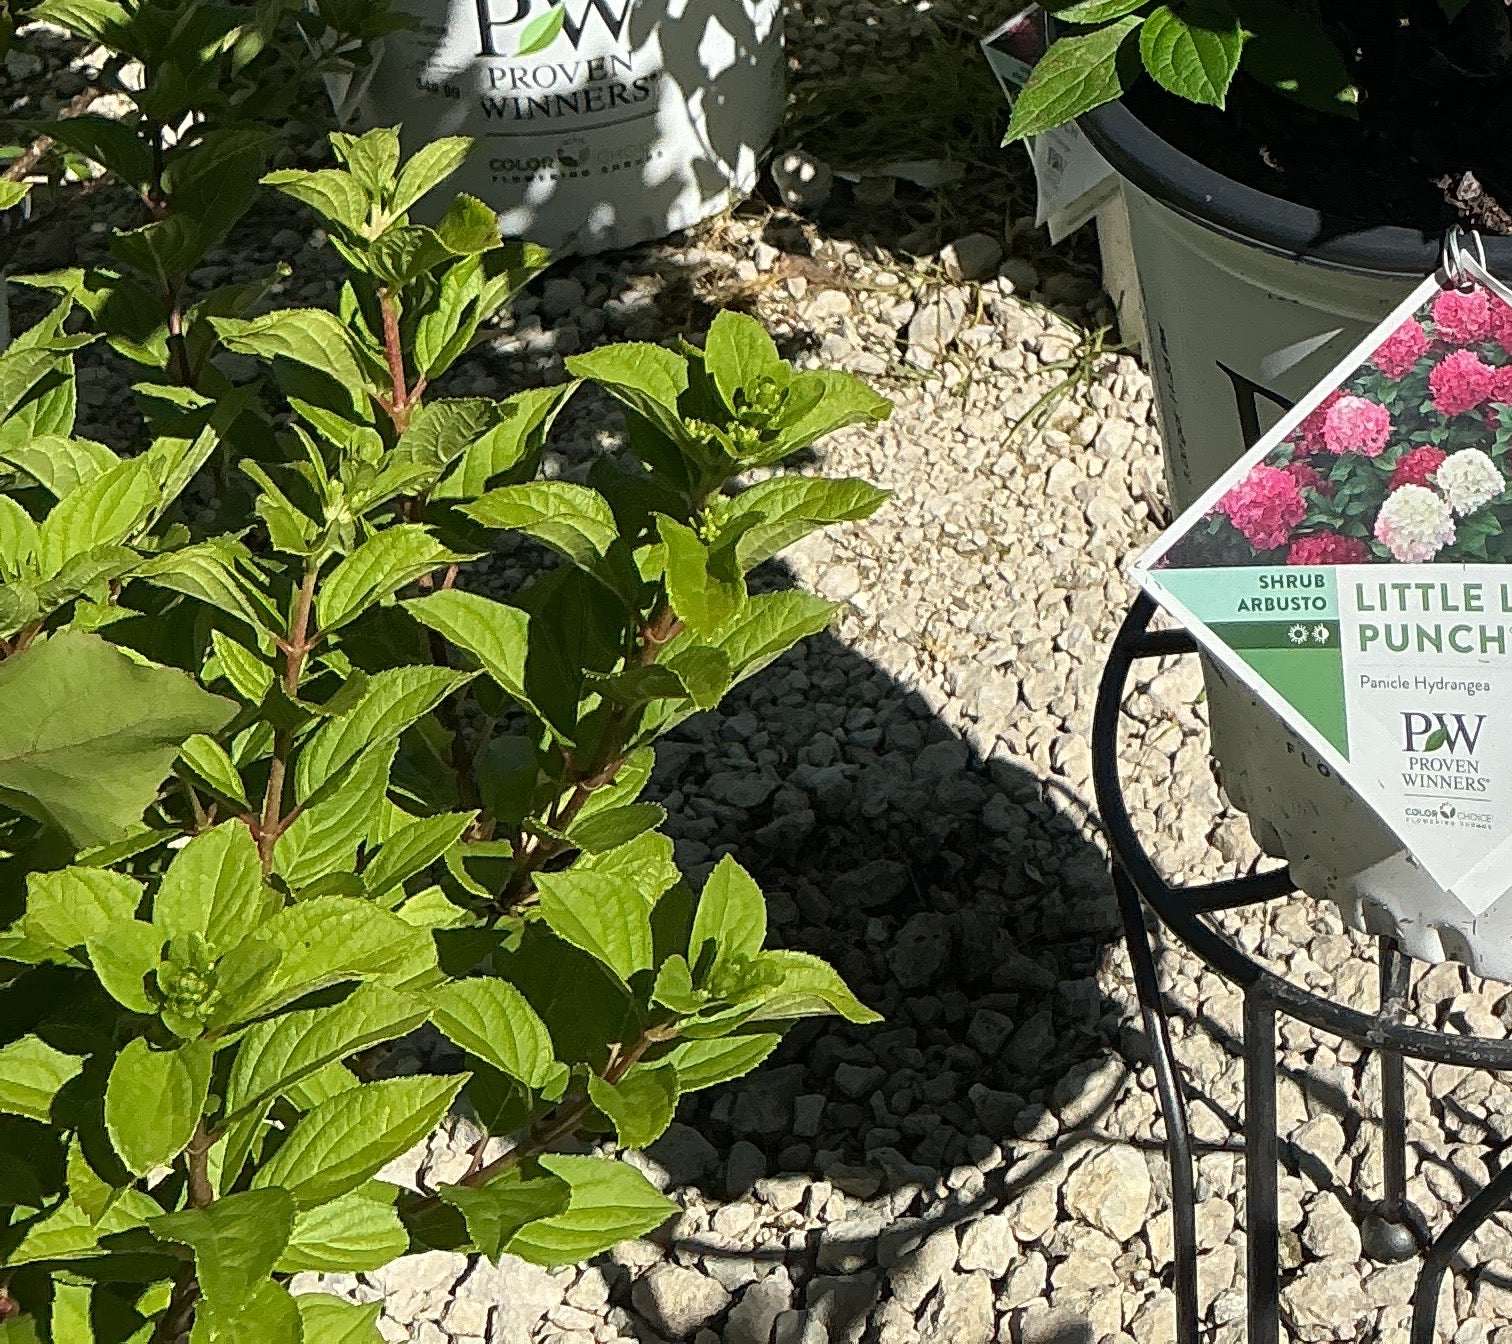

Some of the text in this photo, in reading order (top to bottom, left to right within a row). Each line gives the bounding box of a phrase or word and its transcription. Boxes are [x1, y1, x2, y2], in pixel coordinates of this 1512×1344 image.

[487, 51, 633, 91] PROVEN
[1258, 574, 1326, 591] SHRUB
[1237, 595, 1327, 613] ARBUSTO
[1355, 582, 1485, 613] LITTLE
[1359, 675, 1491, 694] Panicle Hydrangea
[1400, 711, 1488, 756] PW
[1408, 756, 1480, 774] PROVEN
[1404, 807, 1438, 822] COLOR
